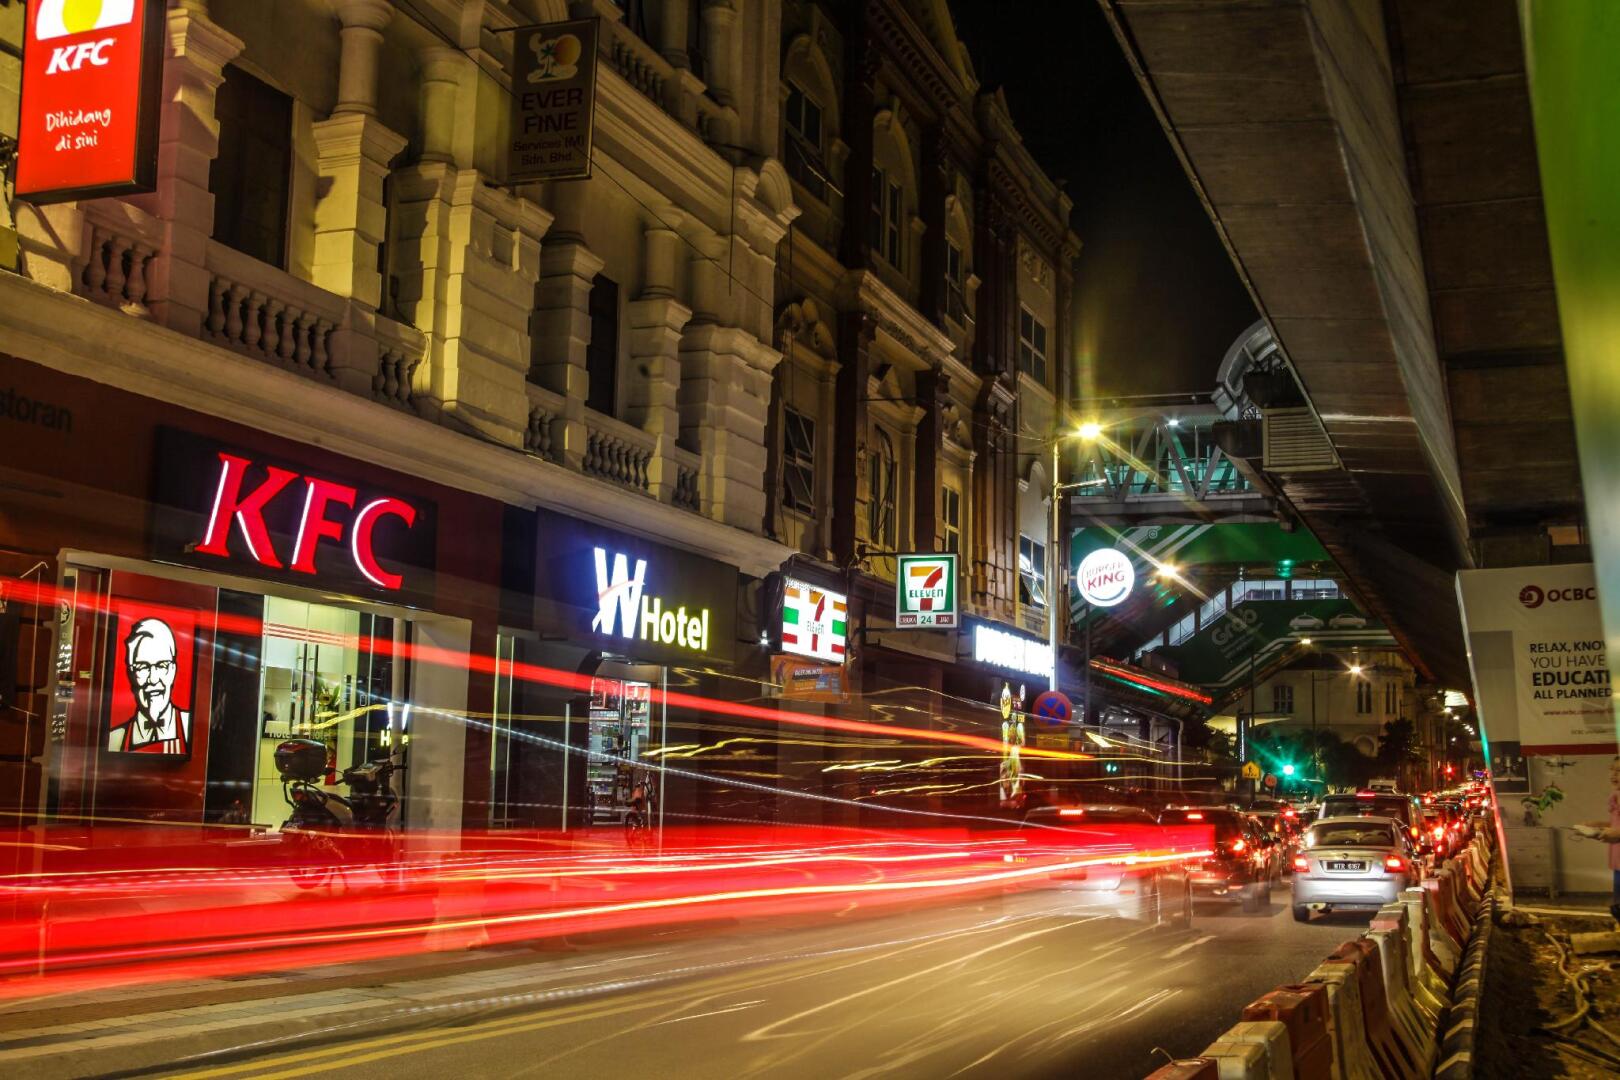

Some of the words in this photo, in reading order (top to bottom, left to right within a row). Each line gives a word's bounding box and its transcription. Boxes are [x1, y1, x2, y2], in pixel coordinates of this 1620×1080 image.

[45, 38, 117, 75] KFC
[521, 88, 583, 111] EVER
[45, 107, 112, 133] Dihidang
[524, 111, 577, 134] FINE
[55, 134, 73, 151] di
[75, 131, 99, 149] sini
[513, 139, 561, 152] Services
[521, 154, 547, 167] Sdn.
[550, 151, 574, 164] Bhd.
[193, 451, 418, 591] KFC
[911, 566, 944, 612] 7
[1087, 571, 1125, 592] KING
[593, 547, 647, 639] W
[641, 596, 710, 651] Hotel
[1547, 587, 1597, 603] OCBC
[809, 589, 827, 653] 7
[920, 615, 932, 624] 24
[1211, 608, 1258, 646] Grab
[1530, 641, 1571, 654] RELAX,
[1530, 656, 1561, 669] YOU
[1566, 654, 1606, 667] HAVE
[1532, 669, 1611, 687] EDUCATI
[1534, 689, 1553, 700] ALL
[1557, 687, 1612, 699] PLANNED
